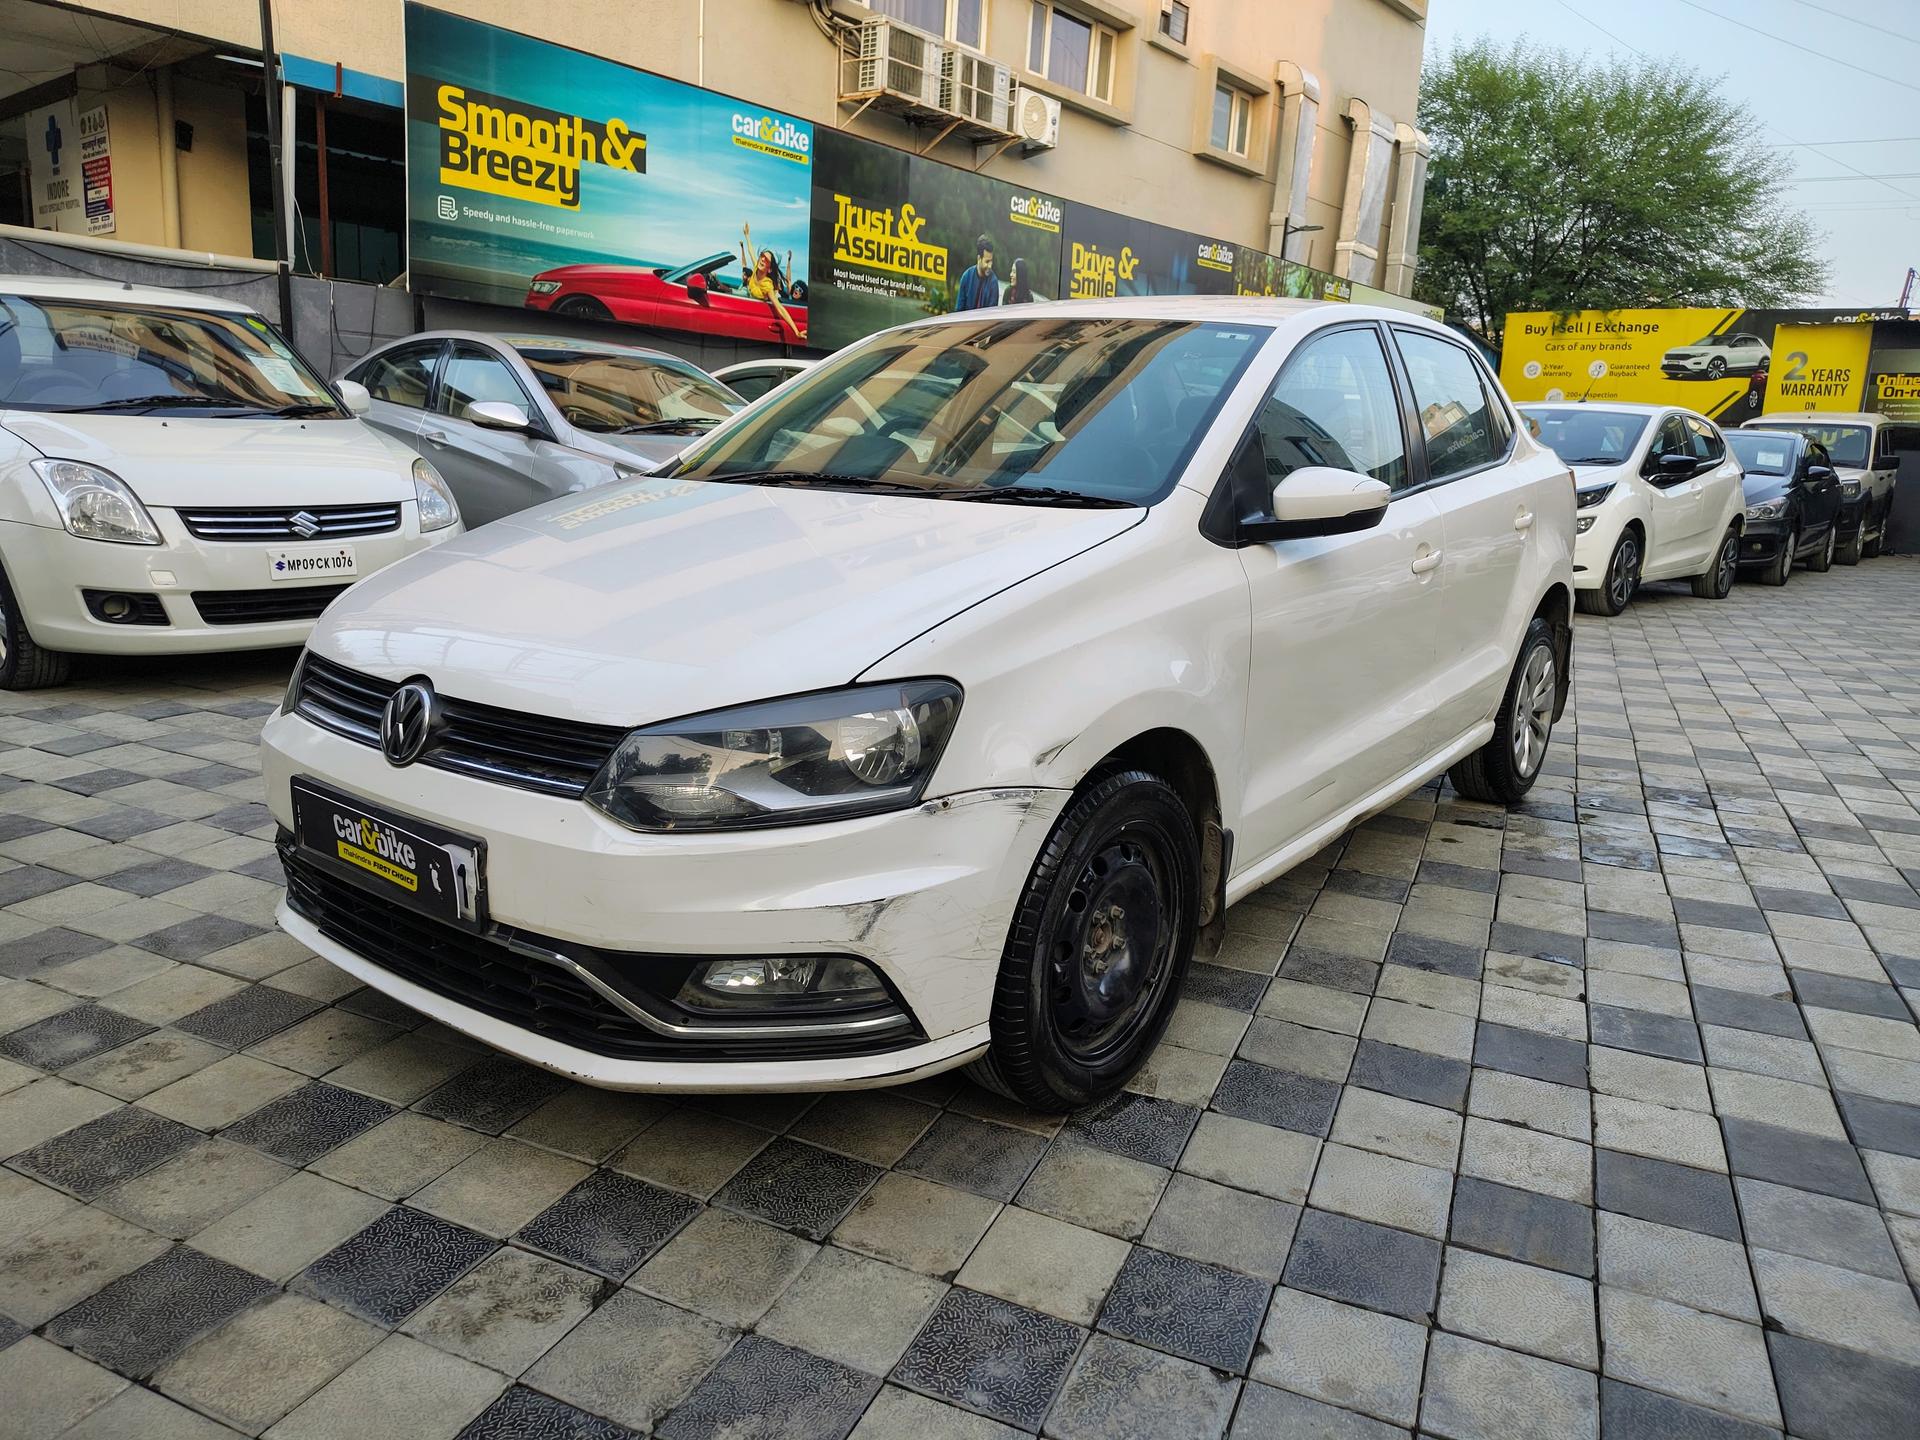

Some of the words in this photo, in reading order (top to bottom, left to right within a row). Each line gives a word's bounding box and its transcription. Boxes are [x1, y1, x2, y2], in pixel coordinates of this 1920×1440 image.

[438, 84, 596, 164] Smooth
[601, 117, 646, 173] &
[732, 113, 809, 152] car&bike
[440, 130, 580, 206] Breezy
[47, 179, 70, 200] INDORE
[834, 193, 894, 238] Trust
[898, 203, 926, 243] &
[1010, 196, 1061, 223] car&bike
[463, 206, 494, 222] Speedy
[495, 213, 511, 224] and
[512, 217, 555, 233] hassle-free
[556, 226, 595, 240] paperwork
[834, 225, 945, 276] Assurance
[1071, 242, 1116, 275] Drive
[1118, 246, 1139, 280] &
[1198, 244, 1233, 264] car&bike
[833, 268, 849, 279] Most
[849, 270, 865, 282] loved
[865, 274, 880, 285] Used
[880, 277, 890, 287] Car
[890, 280, 905, 291] brand
[912, 284, 926, 294] India
[837, 279, 845, 290] By
[846, 281, 873, 294] Franchise
[889, 289, 897, 298] ET
[1070, 269, 1114, 298] Smile
[1525, 323, 1548, 336] Buy
[1595, 321, 1660, 335] Exchange
[1545, 342, 1565, 352] Cars
[1567, 342, 1578, 351] of
[1580, 343, 1596, 353] any
[1599, 341, 1633, 351] brands
[1542, 370, 1573, 378] Warranty
[1608, 370, 1638, 378] Buyback
[1610, 363, 1650, 371] Guaranteed
[1783, 351, 1809, 382] 2
[1811, 368, 1851, 382] YEARS
[1780, 383, 1849, 397] WARRANTY
[1804, 401, 1816, 410] ON
[332, 813, 417, 870] car&bike
[373, 861, 391, 875] FIRST
[391, 870, 415, 887] CHOICE
